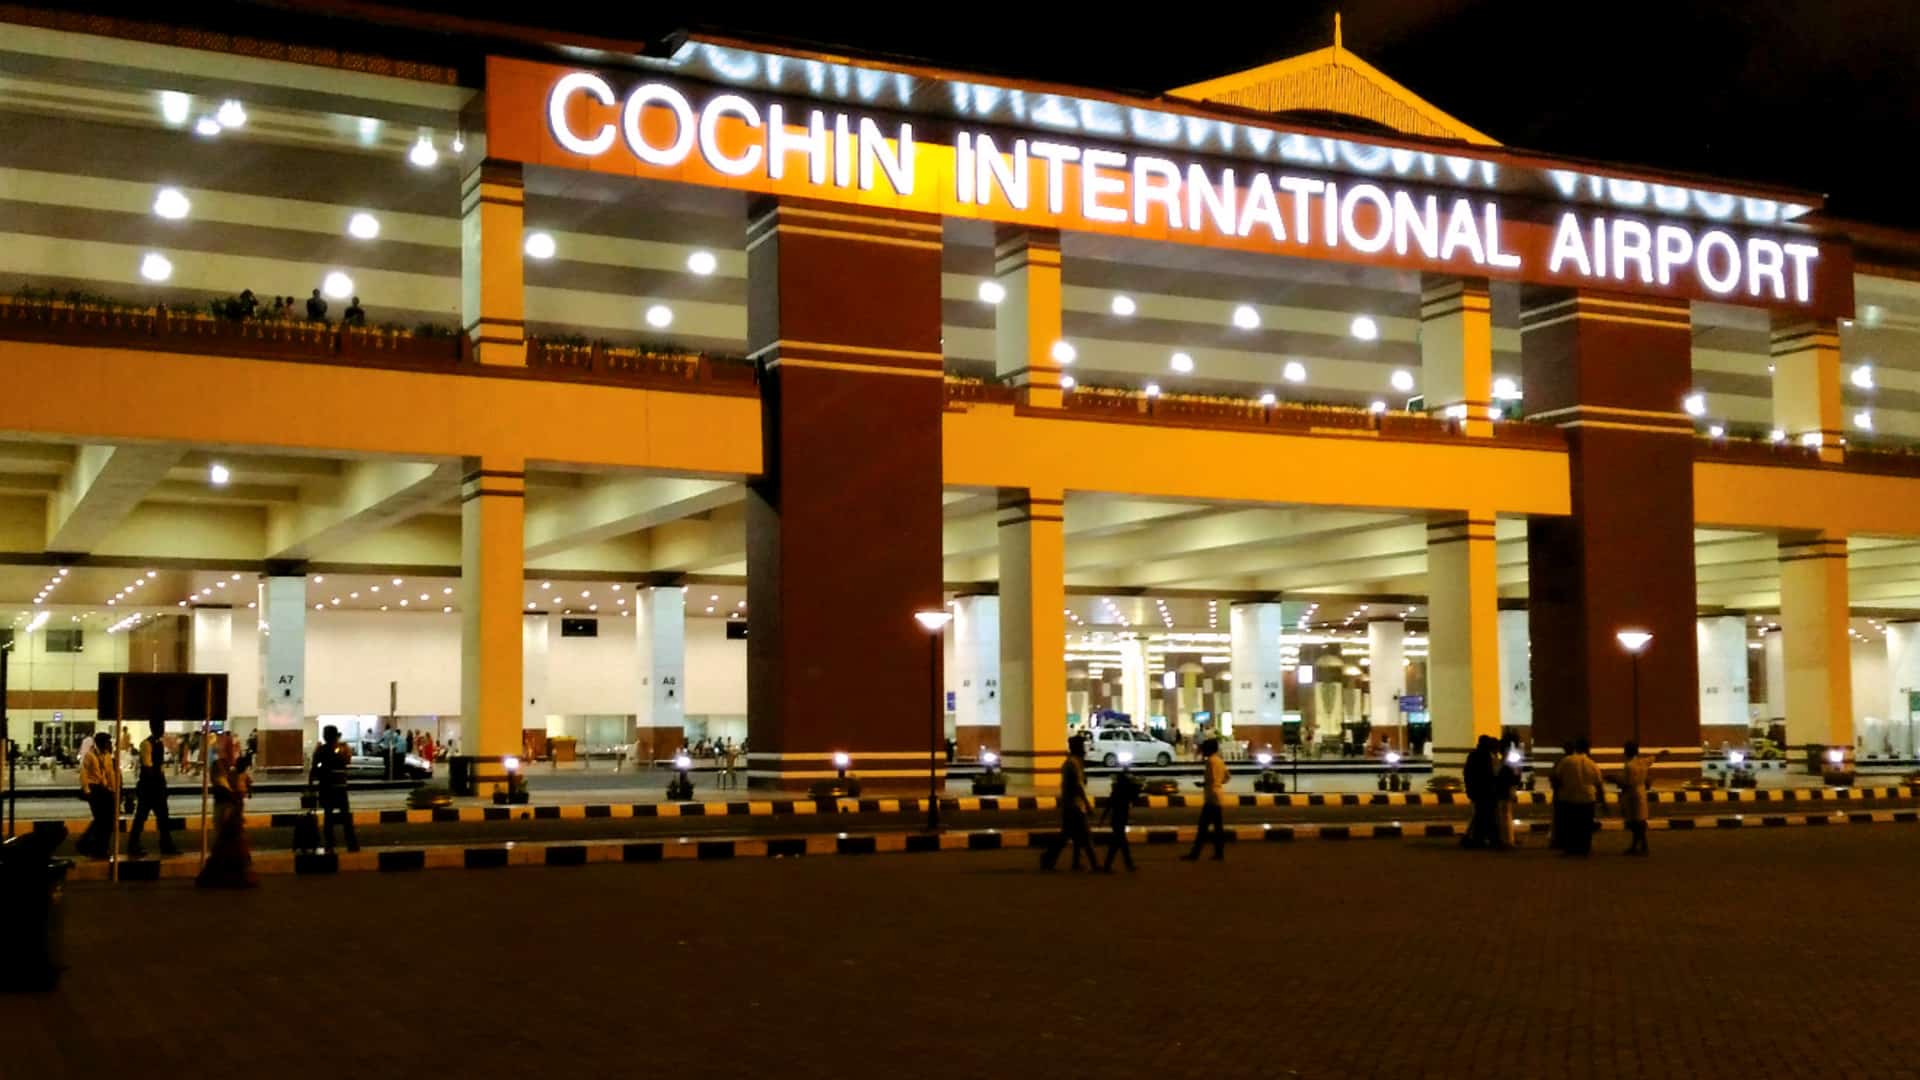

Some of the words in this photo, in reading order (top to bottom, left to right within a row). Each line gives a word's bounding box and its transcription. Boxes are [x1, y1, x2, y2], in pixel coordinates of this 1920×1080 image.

[549, 71, 916, 195] COCHIN
[956, 131, 1522, 269] INTERNATIONAL
[1549, 212, 1819, 302] AIRPORT
[278, 675, 294, 685] A7
